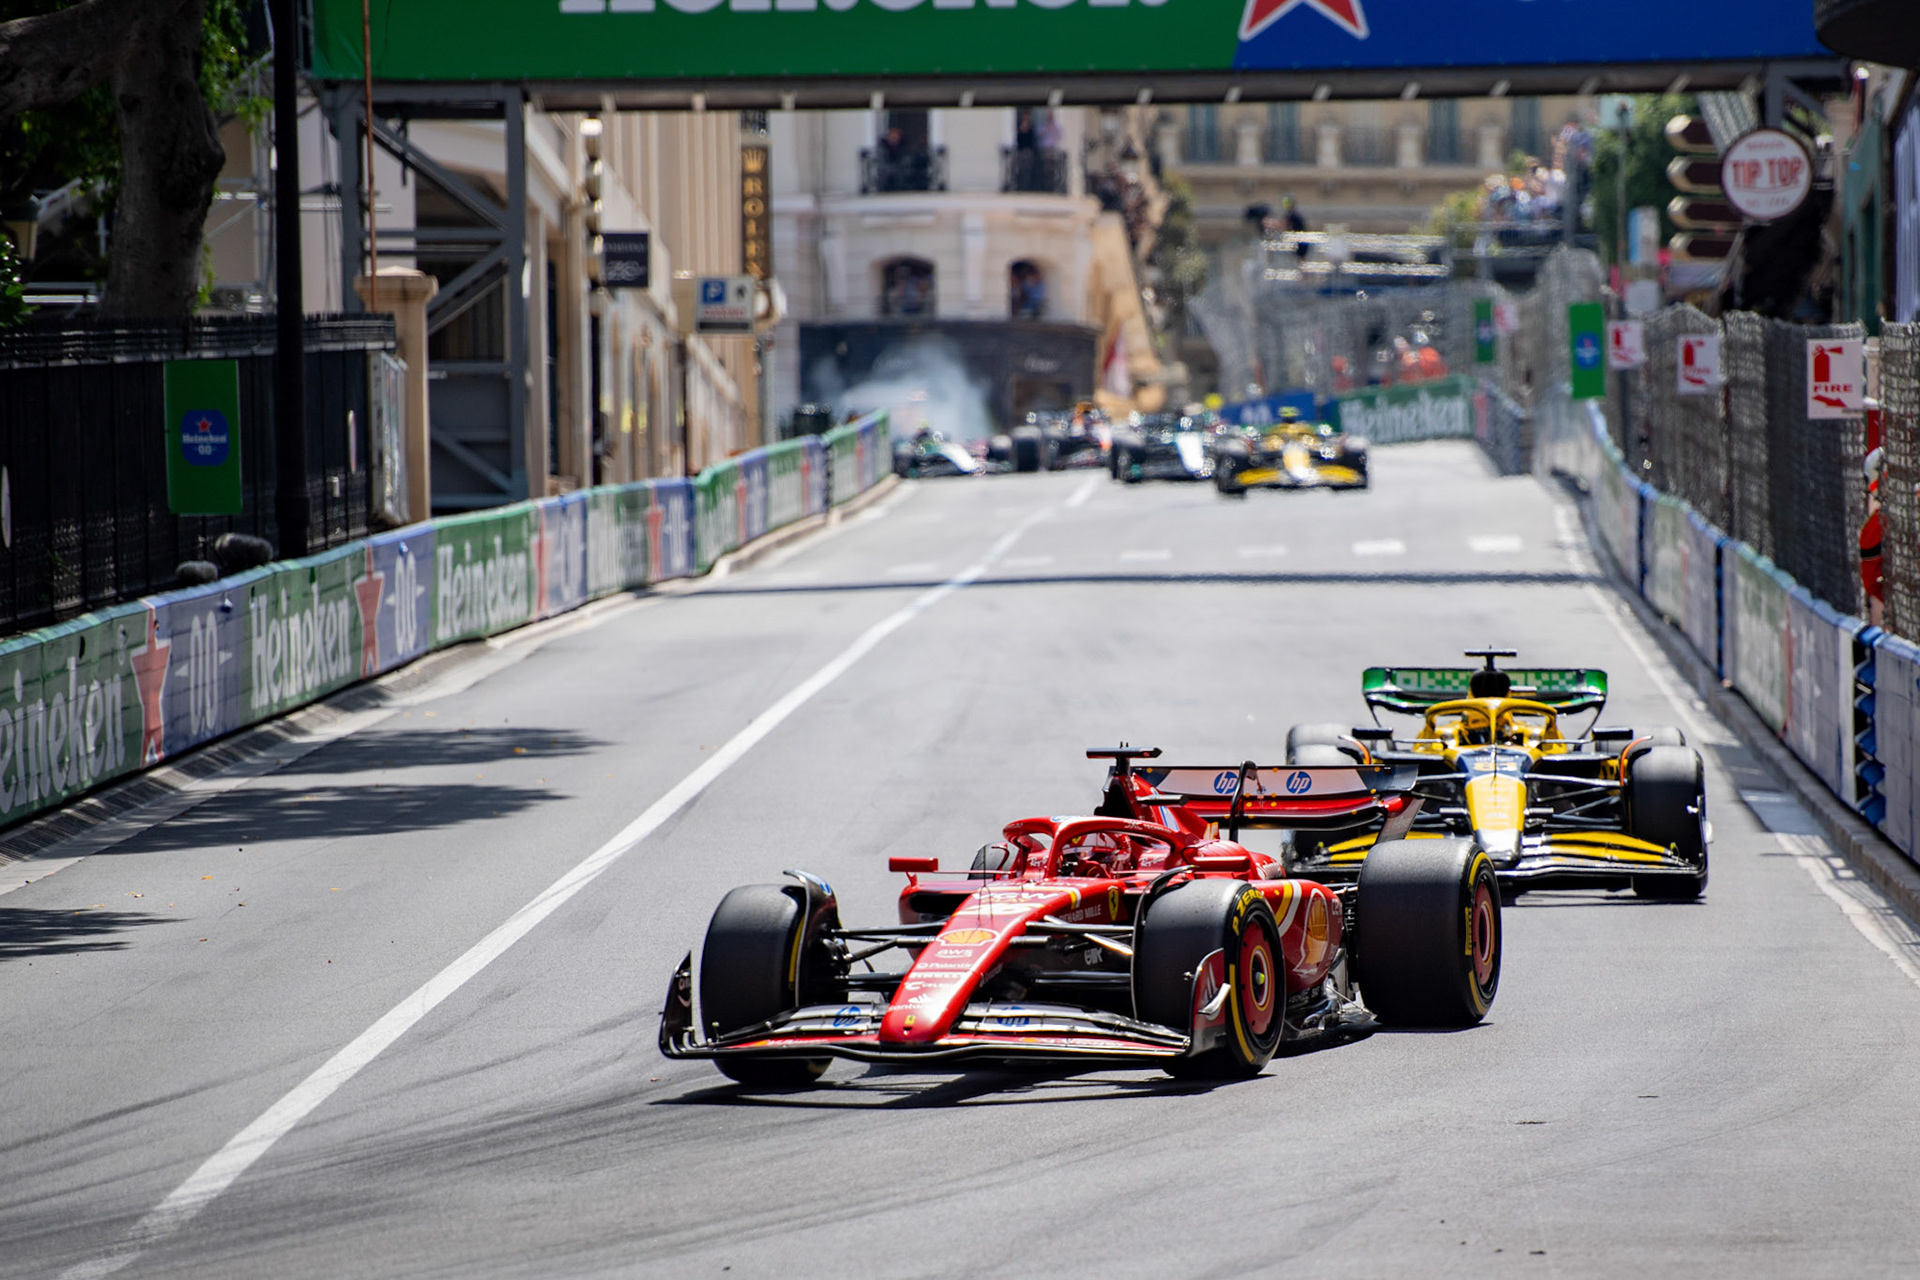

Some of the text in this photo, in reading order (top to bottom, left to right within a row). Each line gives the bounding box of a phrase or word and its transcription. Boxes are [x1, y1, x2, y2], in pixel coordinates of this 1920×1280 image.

[1731, 156, 1805, 188] TIP TOP
[1813, 384, 1853, 393] FIRE
[183, 432, 227, 444] Heineken
[436, 535, 529, 641] Heineken
[251, 581, 350, 710] Heineken
[0, 656, 126, 814] eineken
[1215, 771, 1238, 794] hp
[1286, 771, 1312, 794] hp
[1236, 889, 1264, 917] ZERO
[936, 949, 973, 958] aws
